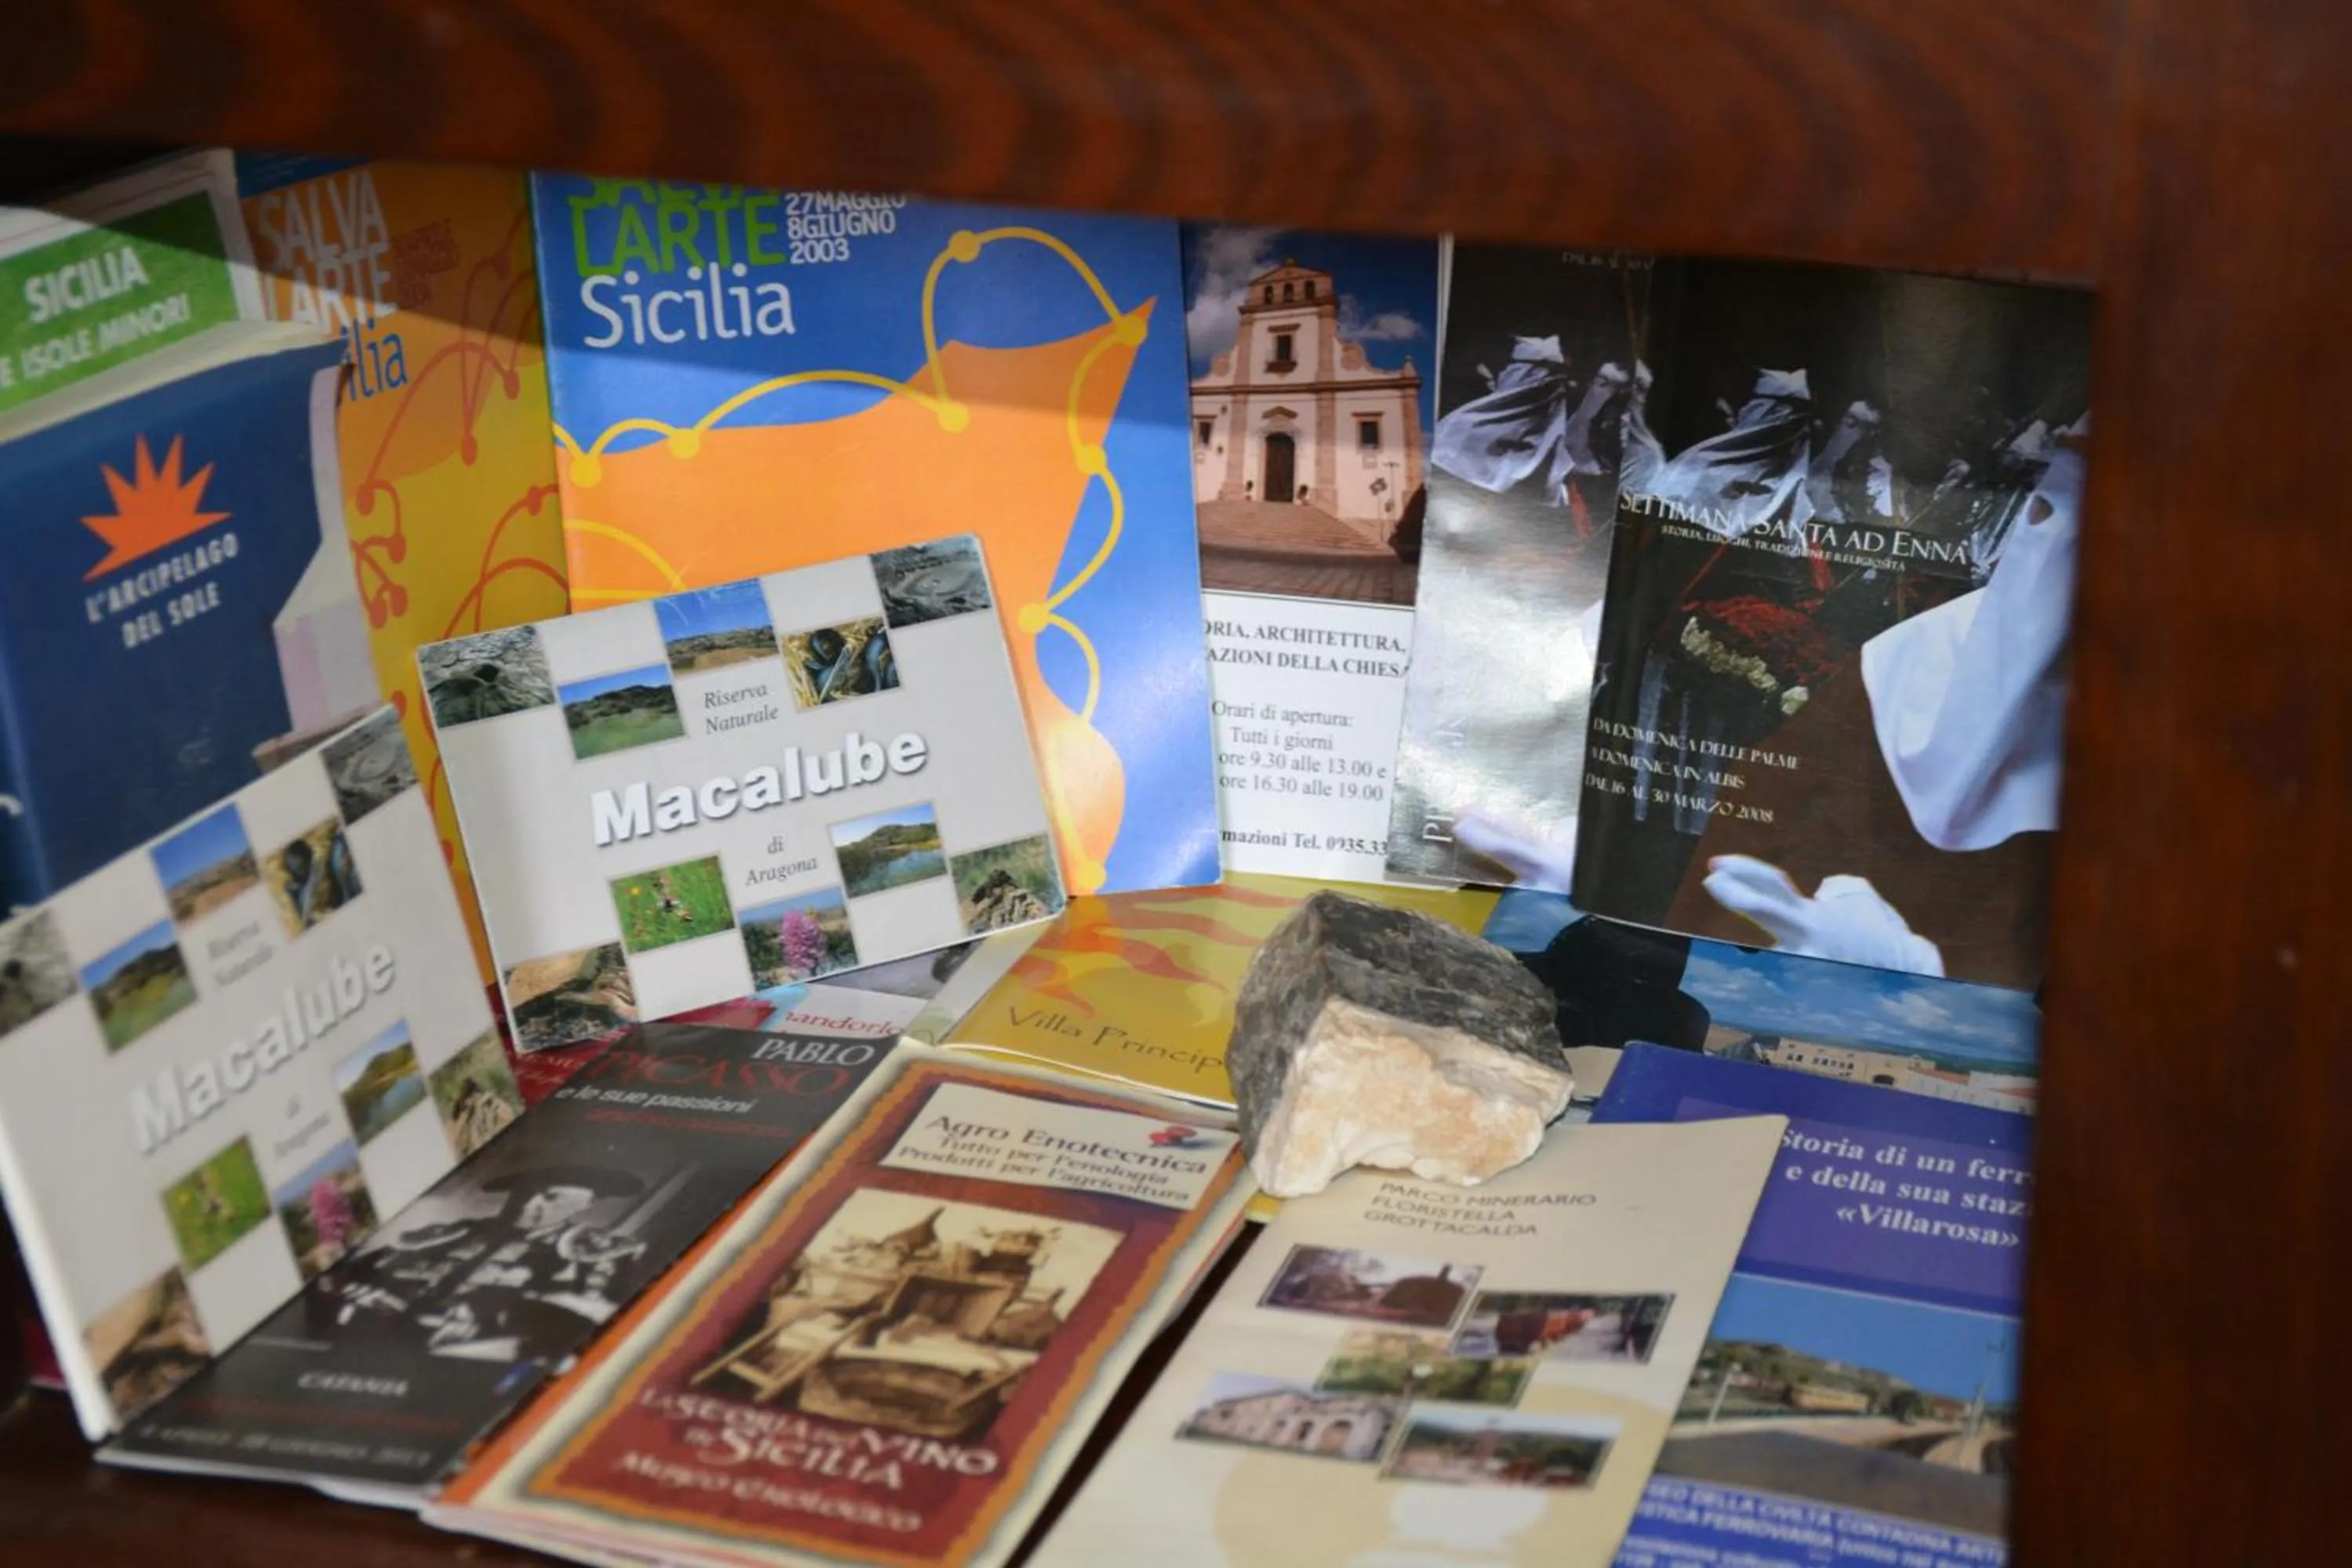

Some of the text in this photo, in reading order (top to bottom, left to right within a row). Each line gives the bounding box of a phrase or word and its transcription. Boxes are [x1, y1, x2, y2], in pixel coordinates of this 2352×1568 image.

[259, 169, 392, 273] SALVA
[789, 238, 850, 264] 2003
[24, 246, 151, 323] SICILIA
[580, 262, 796, 348] Sicilia
[20, 328, 92, 379] ISOLE
[98, 292, 191, 351] MINORI
[1620, 492, 1746, 532] SETTIMANA
[1754, 521, 1837, 547] SANTA
[1849, 530, 1883, 552] AD
[85, 532, 240, 622] L'ARCIPELAGO
[122, 581, 221, 648] DEL SOLE
[1253, 625, 1406, 652] ARCHITETTURA,
[1278, 652, 1338, 673] DELLA
[704, 682, 768, 709] Riserva
[705, 706, 779, 735] Naturale
[1212, 700, 1355, 728] Orari di apertura:
[1229, 727, 1334, 752] Tutti i giorni
[1613, 723, 1697, 751] DOMENICA
[1700, 740, 1749, 762] DELLE
[1751, 750, 1801, 770] PALME
[1220, 752, 1387, 779] ore 9.30 alle 13.00 e
[1599, 749, 1680, 777] DOMENICA
[1705, 772, 1747, 789] ALBIS
[590, 731, 929, 848] Macalube
[1220, 775, 1383, 802] ore 16.30 alle 19.00
[1585, 773, 1774, 823] DAL 16 AL 30 MARZO 2008
[767, 835, 785, 855] di
[1293, 833, 1321, 850] Tel.
[745, 855, 818, 887] Aragona
[126, 943, 397, 1156] Macalube
[750, 1038, 876, 1066] PABLO
[1010, 1006, 1223, 1074] Villa Princip
[587, 1051, 852, 1097] PICASSO
[554, 1087, 575, 1099] e
[599, 1090, 648, 1105] sue
[642, 1093, 757, 1113] passioni
[926, 1115, 1208, 1174] Agro Enotecnica
[940, 1136, 1001, 1158] Tutto
[1007, 1149, 1049, 1167] per
[1781, 1128, 2034, 1186] Storia di un ferr
[898, 1146, 994, 1171] Prodotti
[1000, 1160, 1040, 1178] per
[1380, 1182, 1597, 1207] PARCO MINERARIO
[1785, 1165, 2031, 1218] e della sua staz
[1364, 1210, 1537, 1236] GROTTACALDA
[1372, 1195, 1515, 1222] FLORISTELLA
[696, 1428, 903, 1490] SICILIA
[856, 1428, 1000, 1475] VINO
[1692, 1487, 1755, 1511] DELLA
